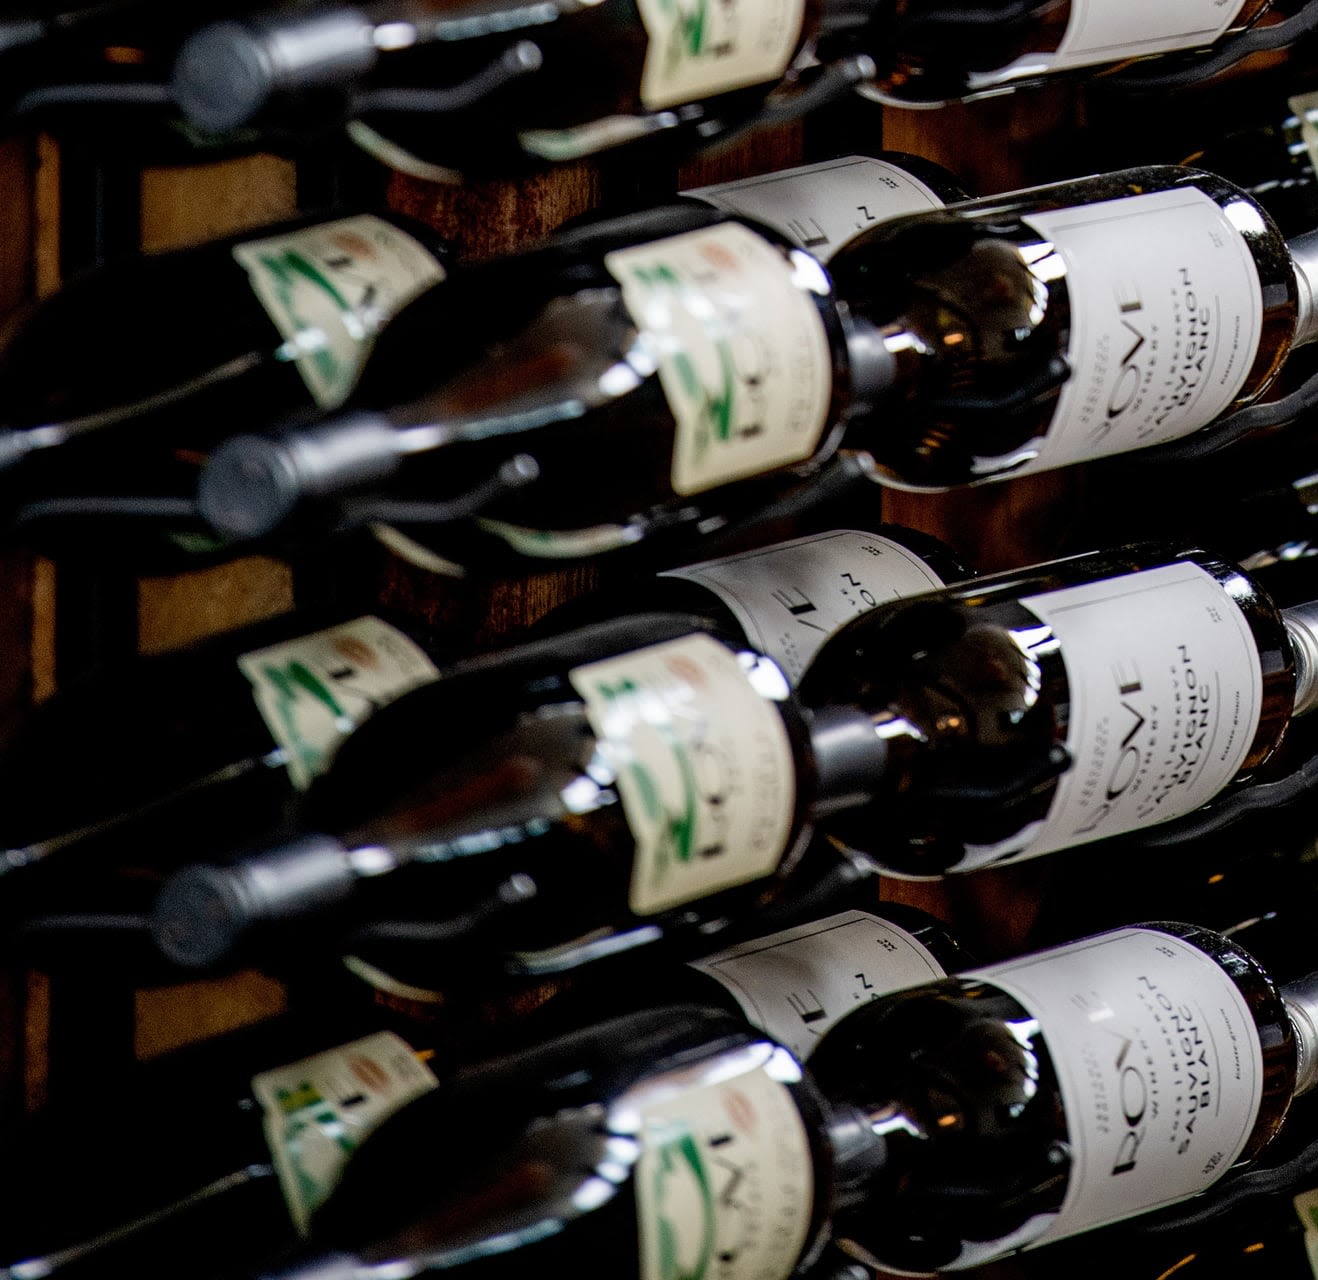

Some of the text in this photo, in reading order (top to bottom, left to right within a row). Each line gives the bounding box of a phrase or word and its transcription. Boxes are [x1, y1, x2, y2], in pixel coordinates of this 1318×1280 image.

[1136, 267, 1197, 440] SAUVIGNON
[1176, 307, 1210, 406] BLANC
[1071, 657, 1146, 837] ROVE
[1137, 644, 1198, 820] SAUVIGNON
[1176, 684, 1210, 785] BLANC
[1137, 975, 1197, 1156] SAUVIGNON
[1178, 1004, 1210, 1108] BLANC
